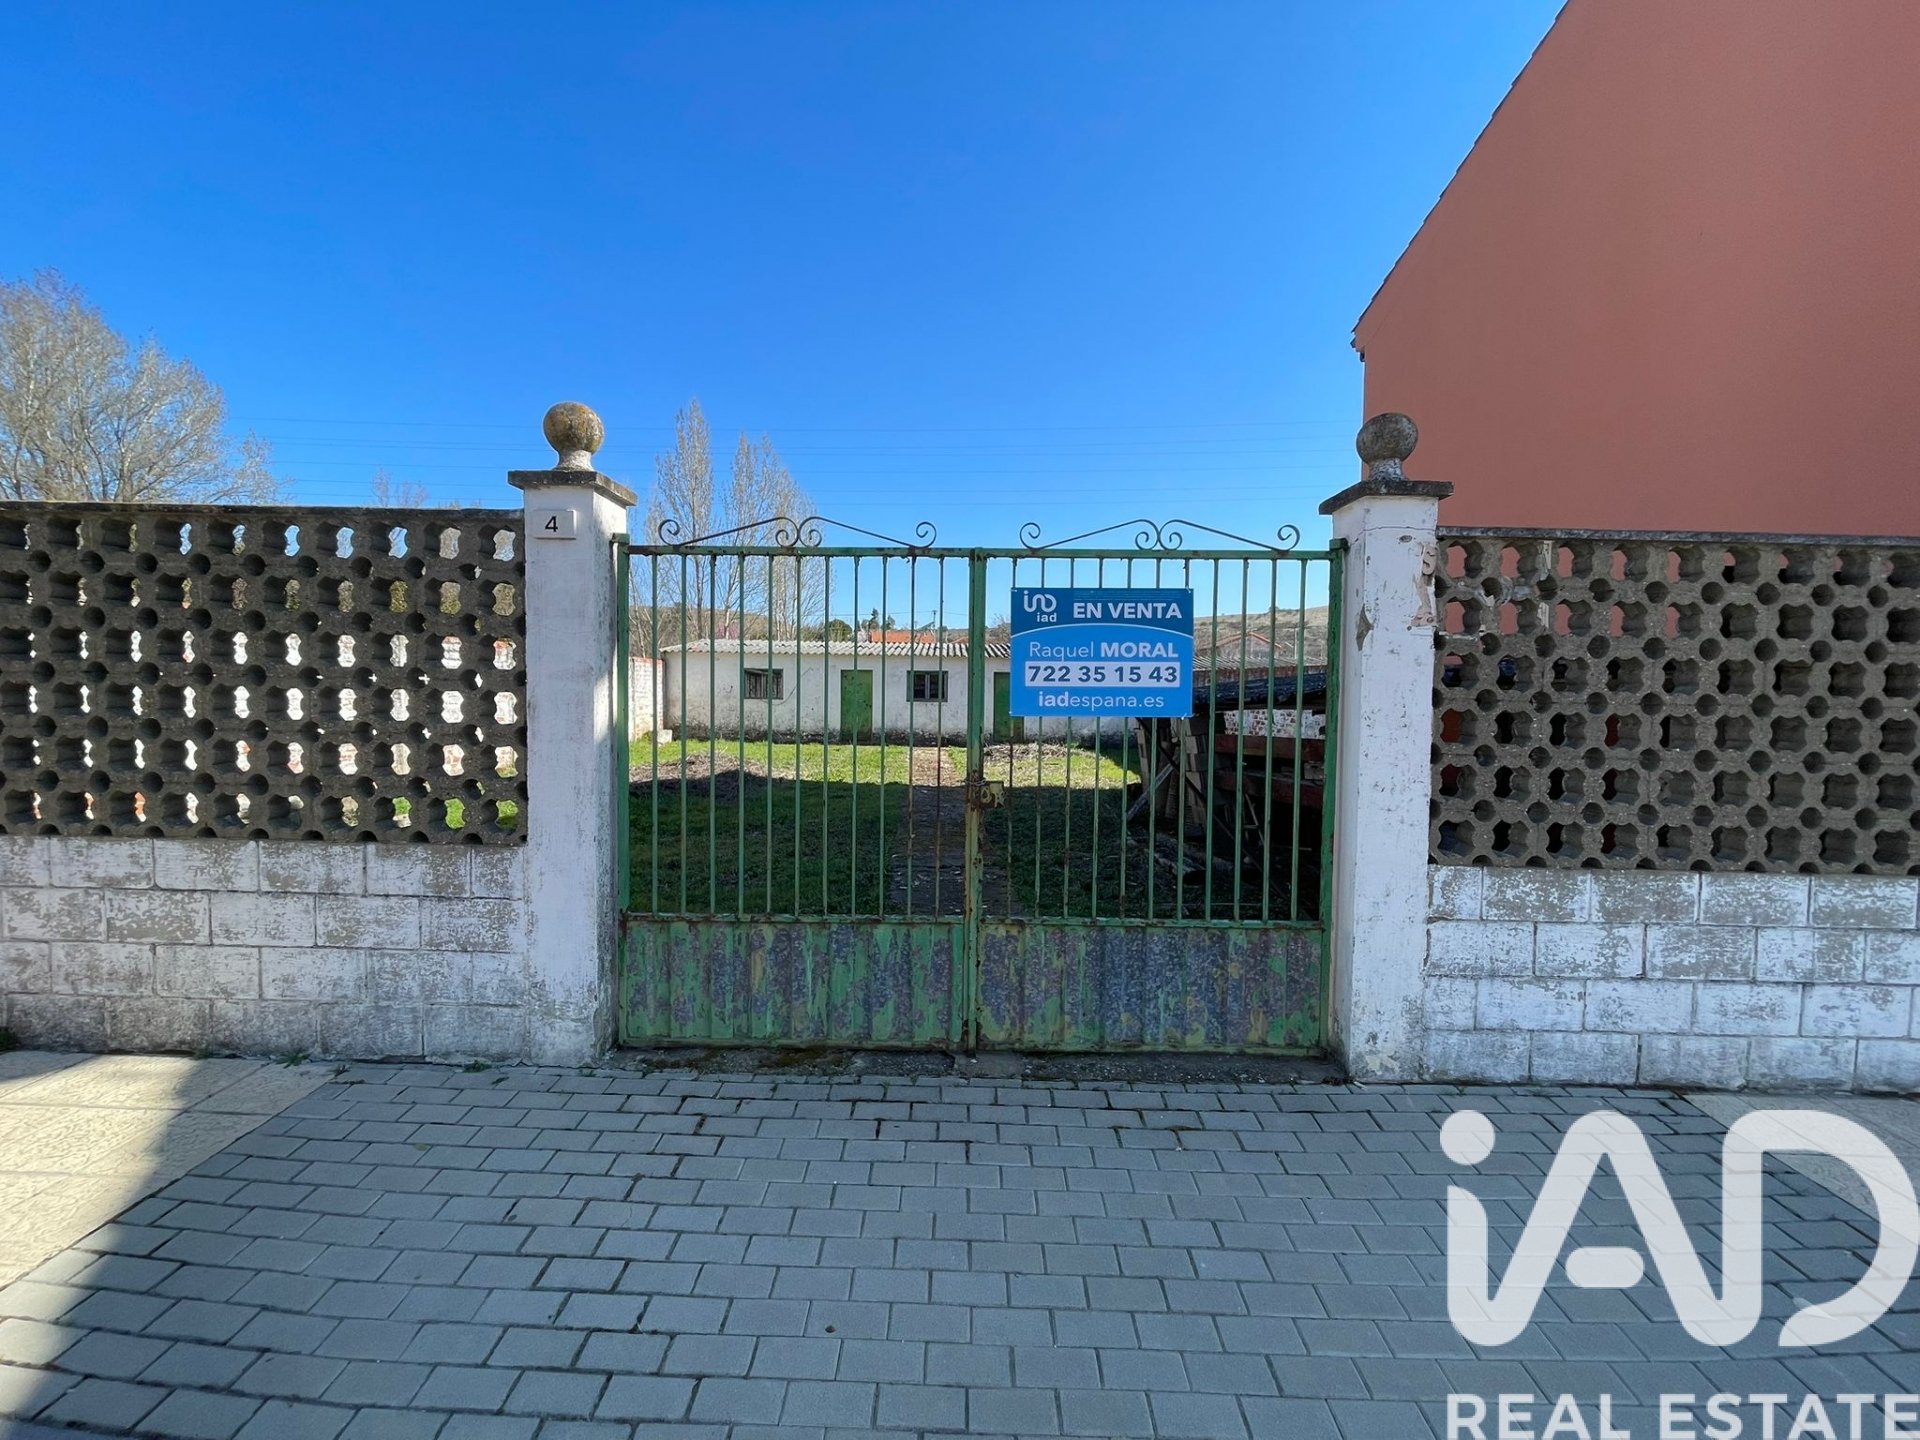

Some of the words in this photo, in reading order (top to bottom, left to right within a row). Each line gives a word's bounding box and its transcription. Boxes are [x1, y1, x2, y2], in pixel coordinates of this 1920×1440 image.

[545, 516, 558, 532] 4
[1036, 612, 1057, 622] iad
[1073, 603, 1102, 619] EN
[1107, 603, 1182, 619] VENTA
[1029, 641, 1094, 661] Raquel
[1101, 642, 1178, 658] MORAL
[1028, 666, 1070, 682] 722
[1078, 666, 1105, 682] 35
[1115, 666, 1141, 682] 15
[1148, 666, 1177, 682] 43
[1039, 691, 1164, 711] iadespana.es
